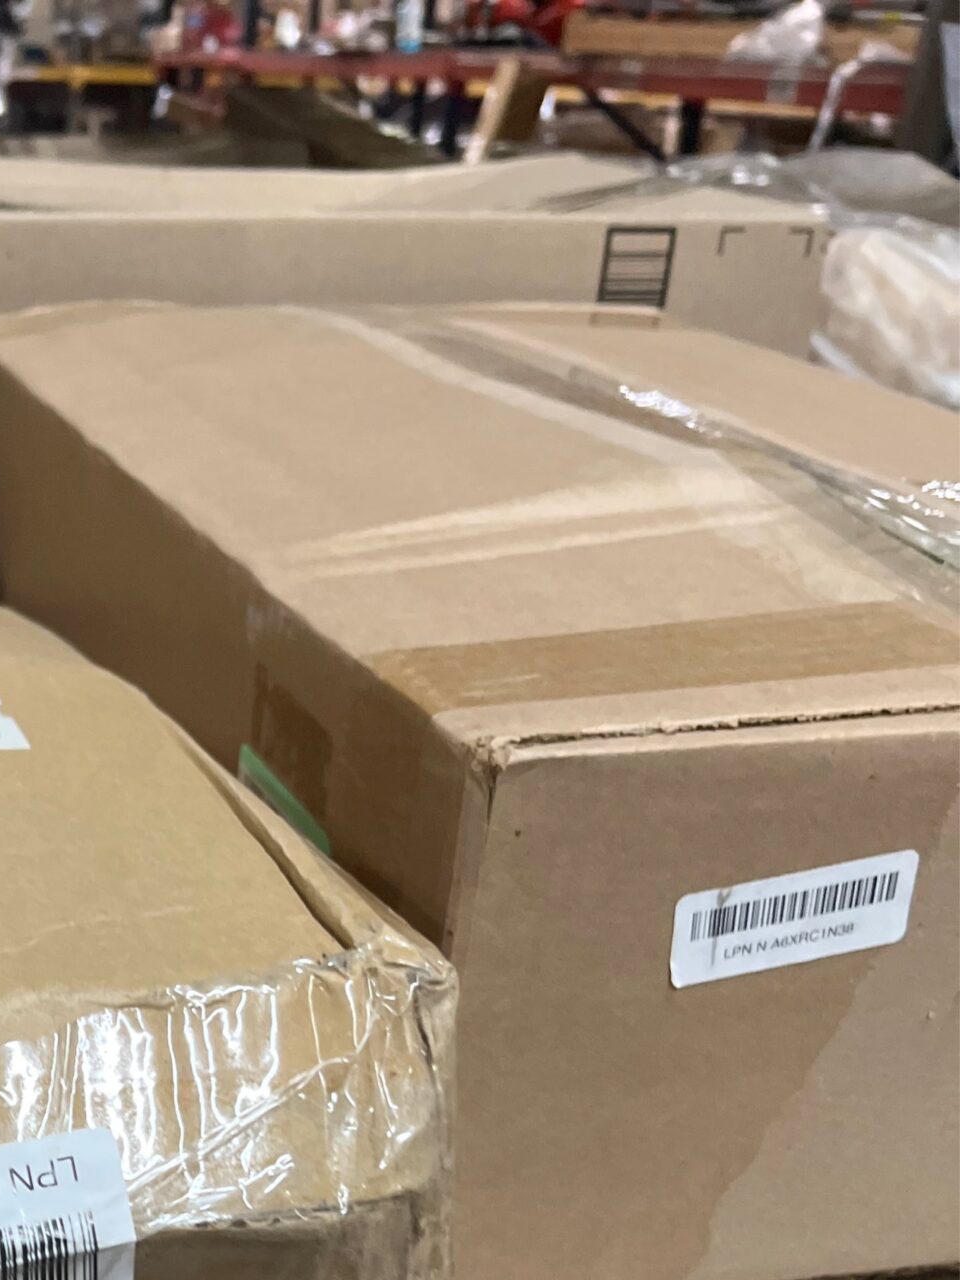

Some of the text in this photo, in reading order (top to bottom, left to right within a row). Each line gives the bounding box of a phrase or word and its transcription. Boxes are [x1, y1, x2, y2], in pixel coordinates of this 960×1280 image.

[723, 942, 753, 960] LPN
[756, 940, 768, 953] N
[8, 1154, 80, 1194] LPN
